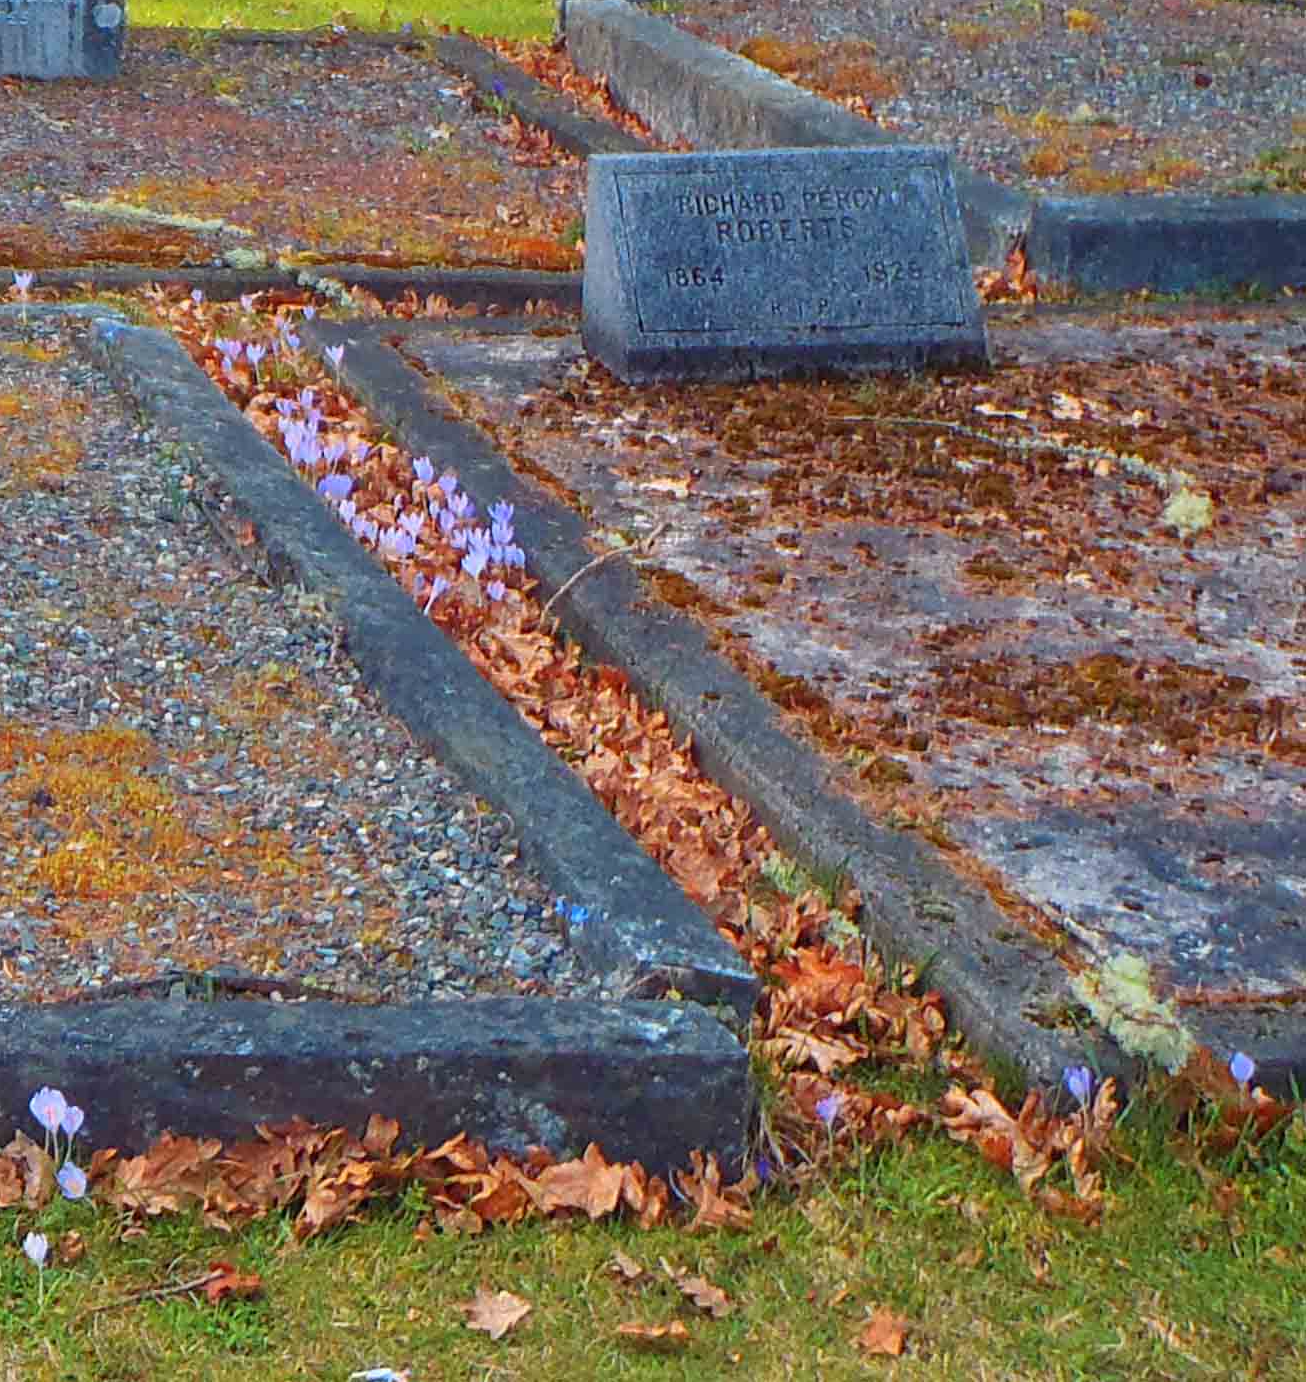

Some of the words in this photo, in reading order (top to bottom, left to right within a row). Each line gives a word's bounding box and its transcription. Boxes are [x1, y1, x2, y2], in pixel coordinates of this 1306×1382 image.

[675, 189, 785, 215] RICHARD
[801, 185, 880, 212] PERCY
[715, 218, 855, 244] ROBERTS
[666, 264, 725, 288] 1864
